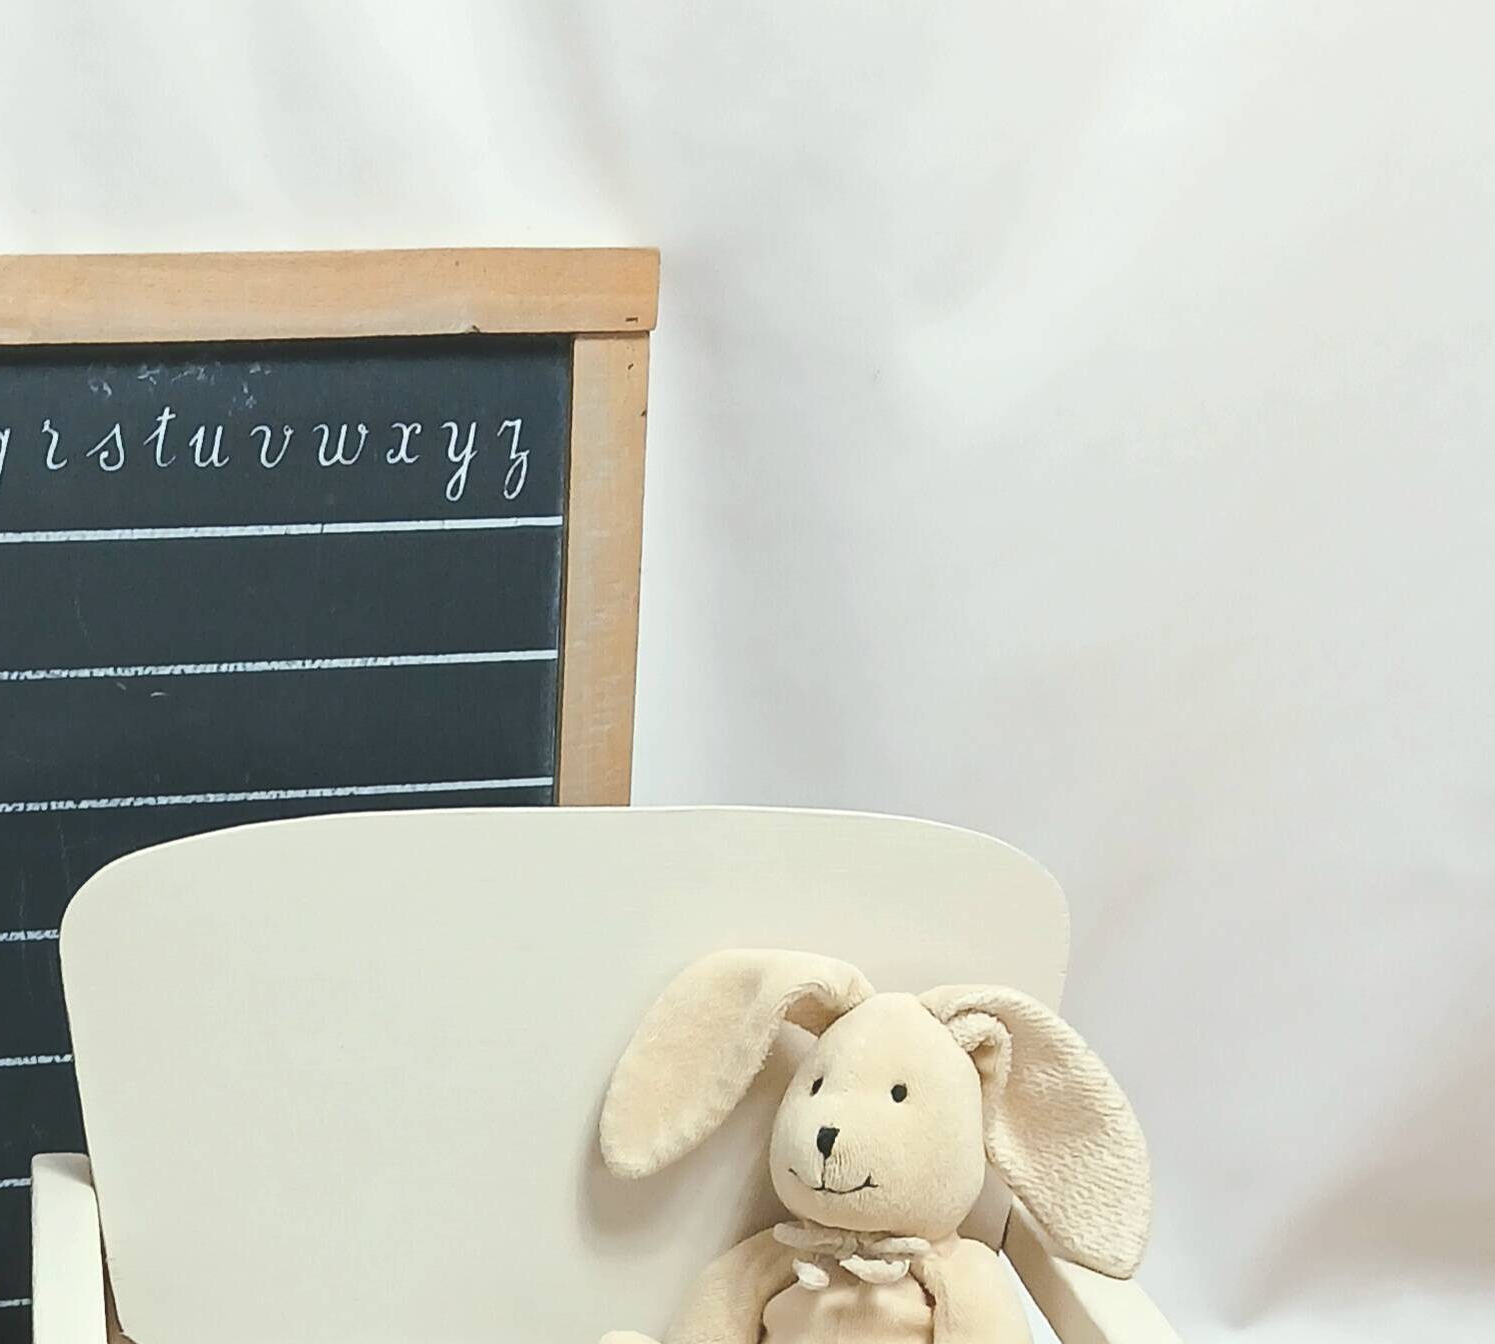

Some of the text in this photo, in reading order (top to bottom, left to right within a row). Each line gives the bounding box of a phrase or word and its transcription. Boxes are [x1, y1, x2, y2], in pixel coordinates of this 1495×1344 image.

[85, 423, 125, 472] s
[143, 406, 177, 468] t
[188, 425, 230, 468] u
[250, 424, 294, 469] v
[312, 423, 369, 467] w
[386, 422, 422, 464] x
[441, 421, 478, 502] y
